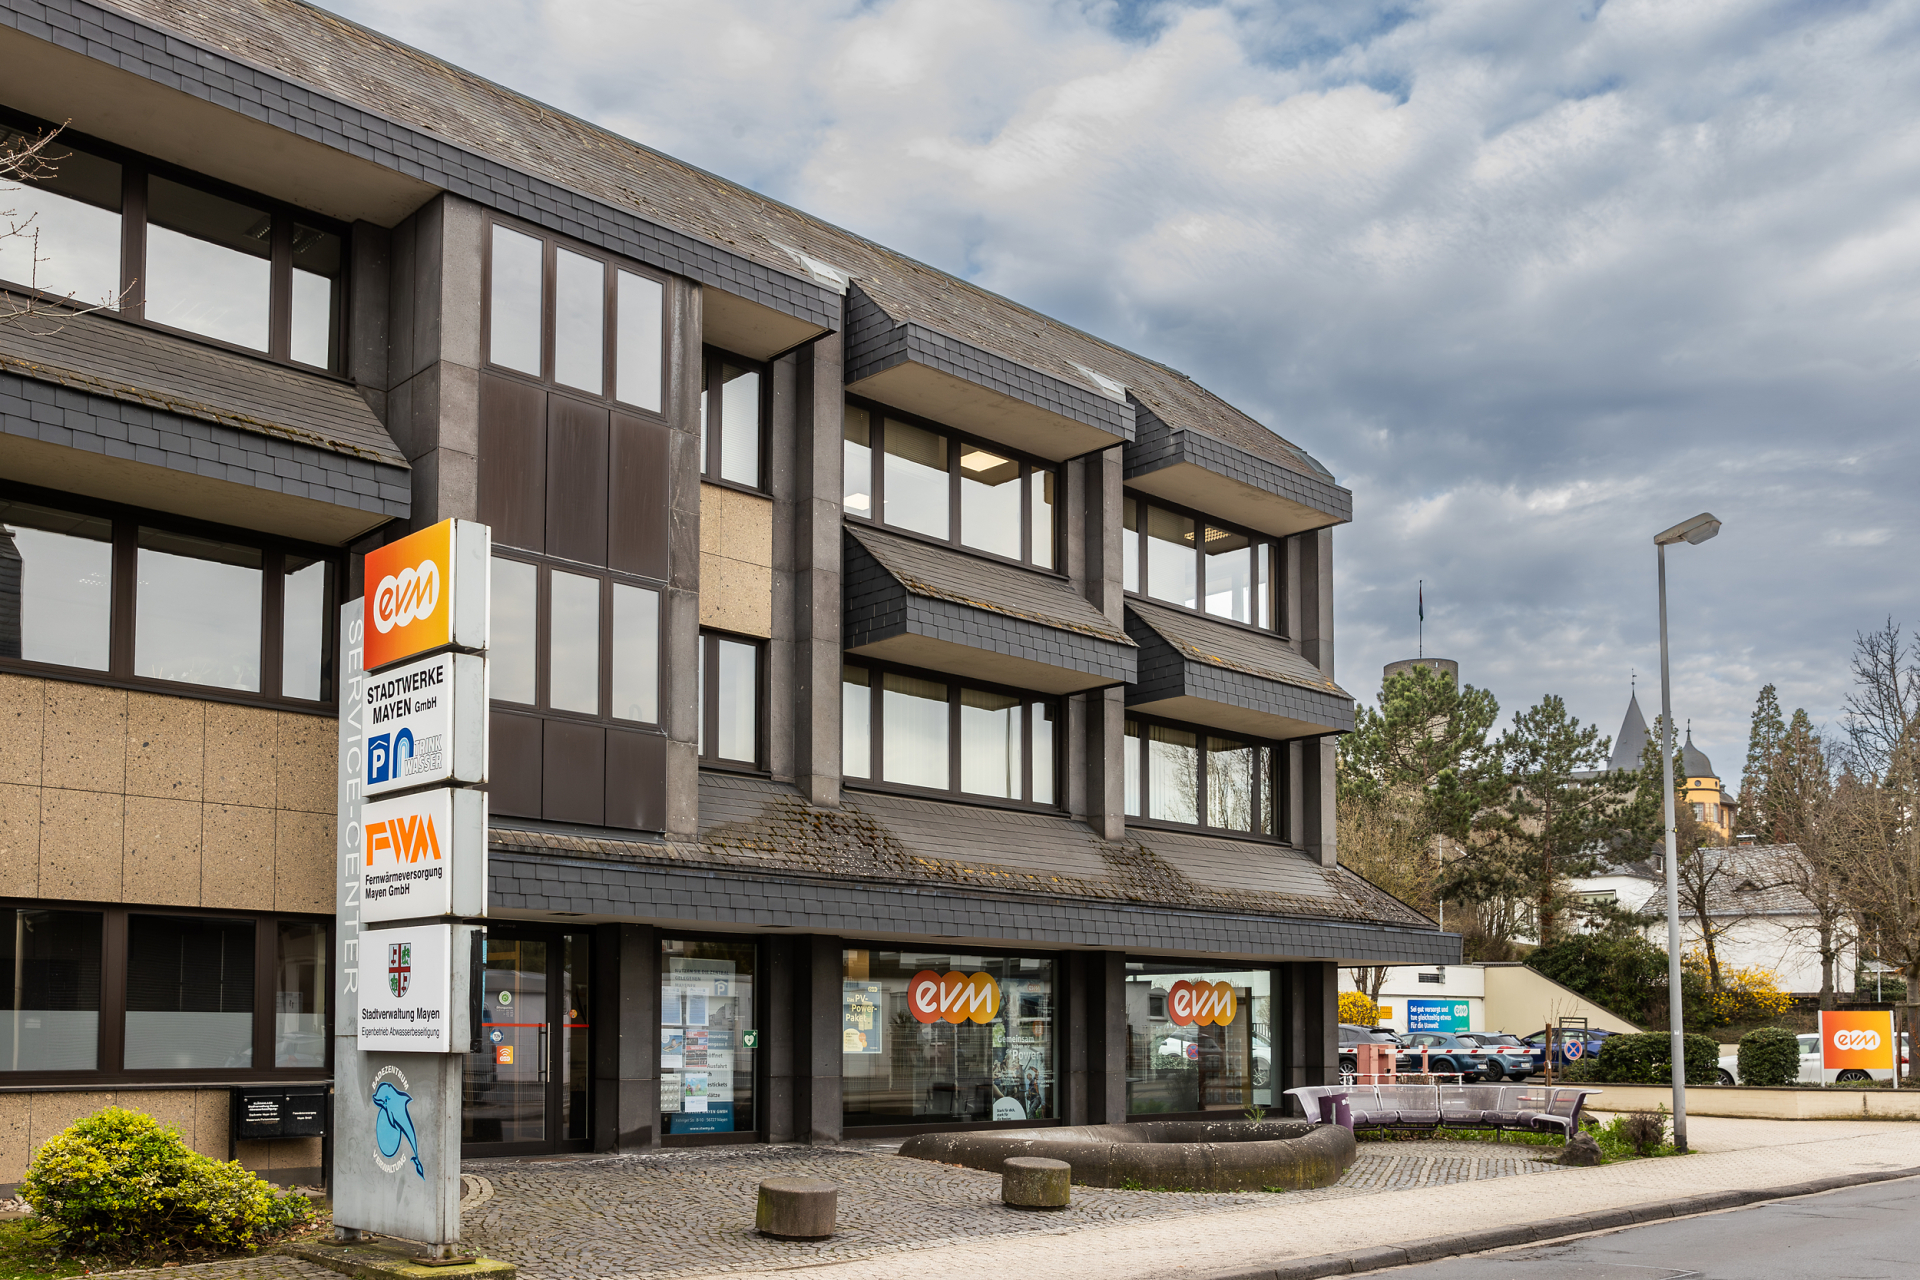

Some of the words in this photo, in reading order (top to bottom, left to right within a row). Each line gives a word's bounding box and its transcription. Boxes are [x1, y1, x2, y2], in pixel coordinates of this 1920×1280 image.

[378, 569, 434, 623] evm
[367, 665, 444, 705] STADTWERKE
[372, 698, 412, 725] MAYEN
[414, 696, 437, 713] GmbH
[414, 734, 443, 752] TRINK
[372, 747, 386, 779] P
[404, 752, 443, 777] WASSER
[343, 619, 363, 995] SERVICE-CENTER
[365, 866, 443, 886] Fernwärmeversorgung
[365, 886, 387, 901] Mayen
[388, 883, 410, 897] GmbH
[855, 995, 868, 1003] PV-
[915, 980, 992, 1014] evm
[1174, 988, 1231, 1018] evm
[361, 1009, 416, 1022] Stadtverwaltung
[416, 1008, 440, 1021] Mayen
[845, 1014, 867, 1022] Paket
[851, 1004, 878, 1013] Power-
[361, 1026, 389, 1038] Eigenbetrieb
[389, 1026, 440, 1039] Abwasserbeseitigung
[997, 1035, 1035, 1043] Gemeinsam
[1838, 1033, 1876, 1046] evm
[371, 1065, 409, 1090] BADEZENTRUM
[372, 1150, 407, 1174] VERWALTUNG
